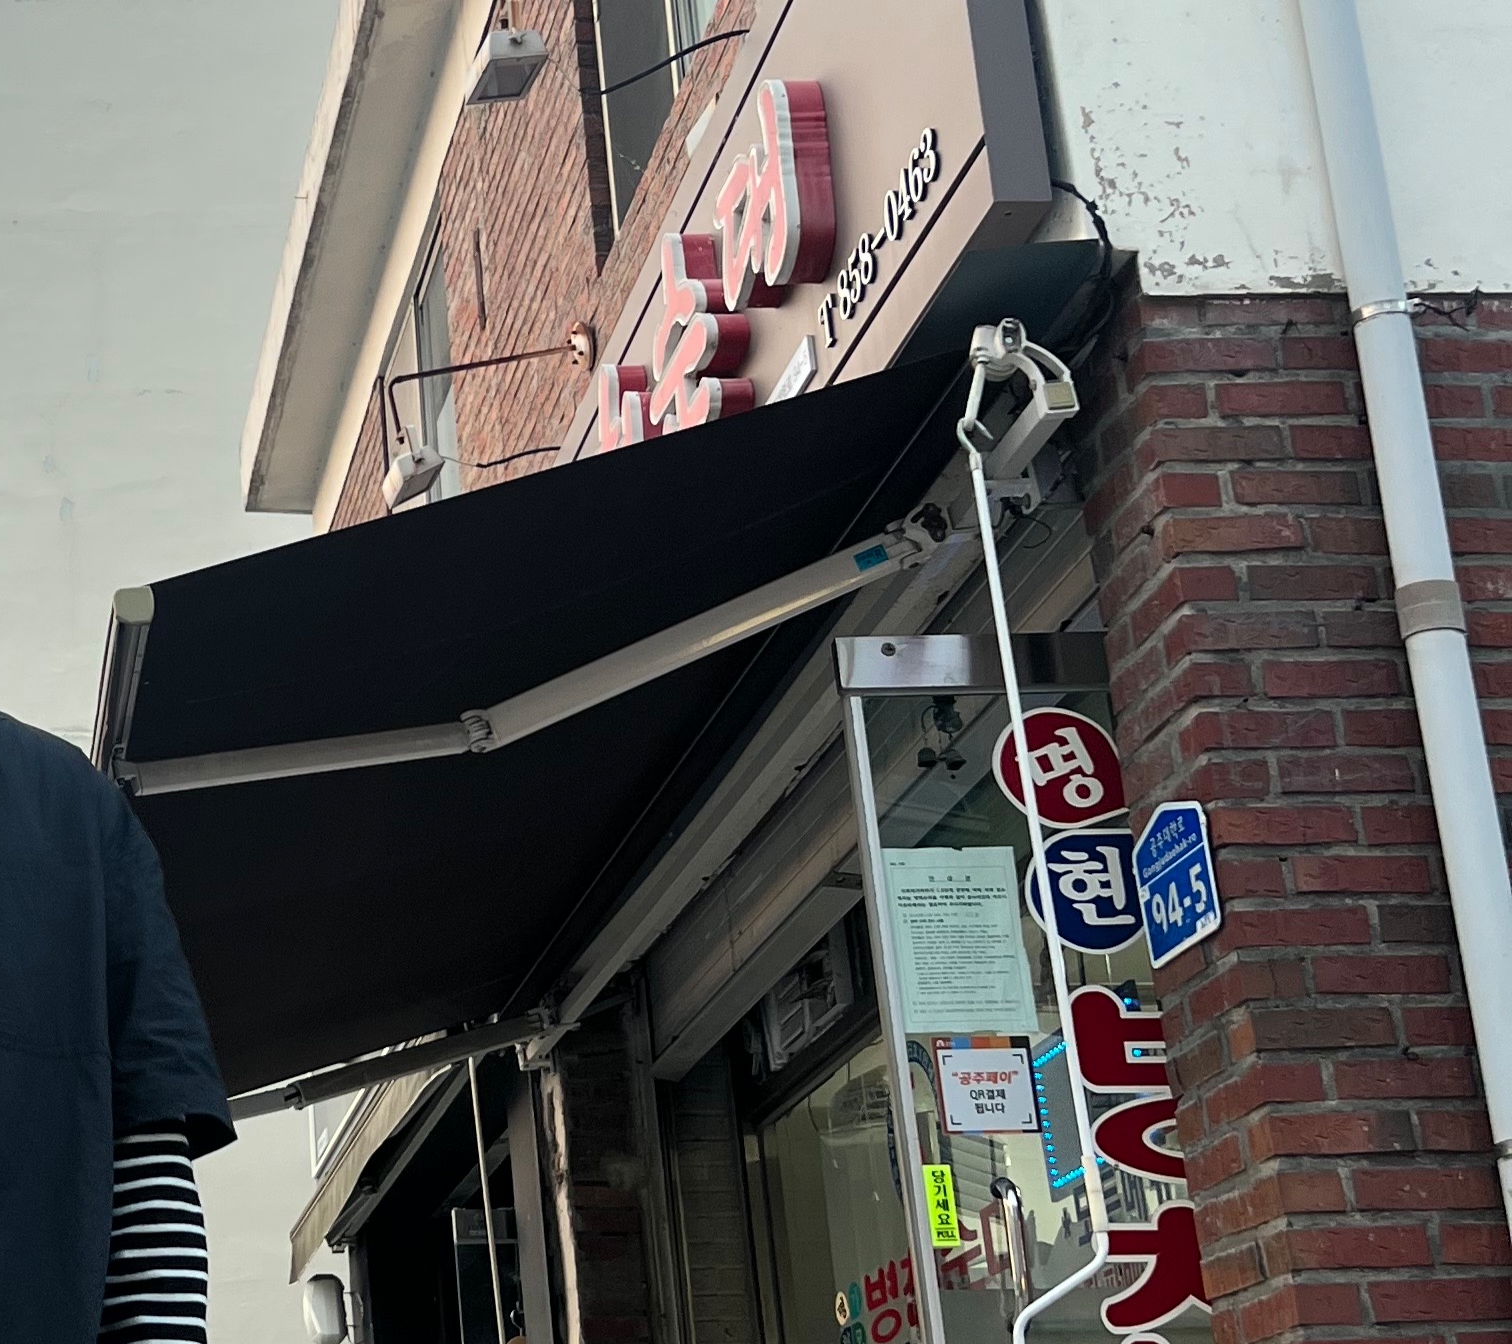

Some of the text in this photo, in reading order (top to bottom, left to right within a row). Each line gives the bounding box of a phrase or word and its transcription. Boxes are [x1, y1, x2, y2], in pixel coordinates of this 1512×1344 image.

[836, 127, 940, 320] 858-0463
[1149, 815, 1186, 858] 공주대학로
[1151, 862, 1207, 934] 94-5
[969, 1088, 1007, 1101] QR결제
[974, 1102, 1006, 1115] 됩니다
[931, 1169, 952, 1225] 당기세요
[936, 1230, 956, 1239] PULL
